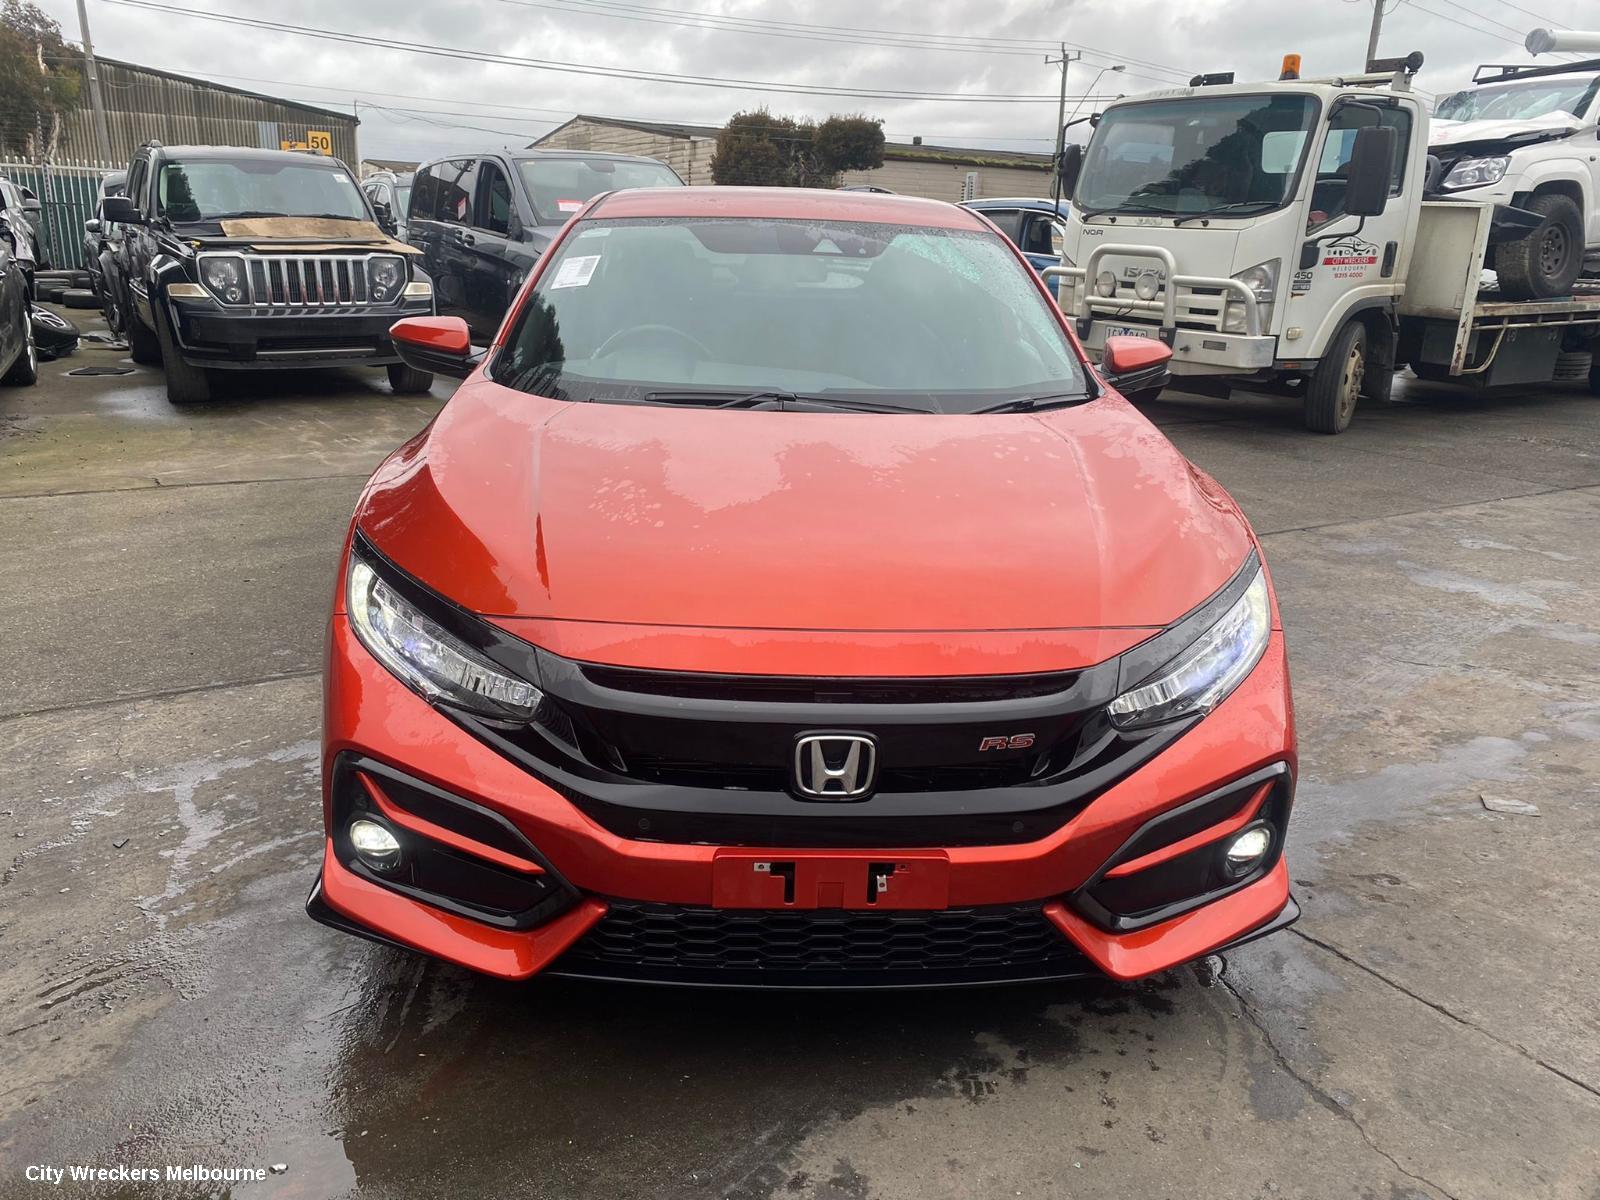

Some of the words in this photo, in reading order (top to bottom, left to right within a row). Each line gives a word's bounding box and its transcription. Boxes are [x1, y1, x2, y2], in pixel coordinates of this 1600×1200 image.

[311, 136, 329, 150] 50
[1332, 257, 1344, 265] CITY
[1344, 256, 1369, 264] WRECKERS
[1294, 271, 1313, 280] 450
[979, 733, 1036, 751] RS
